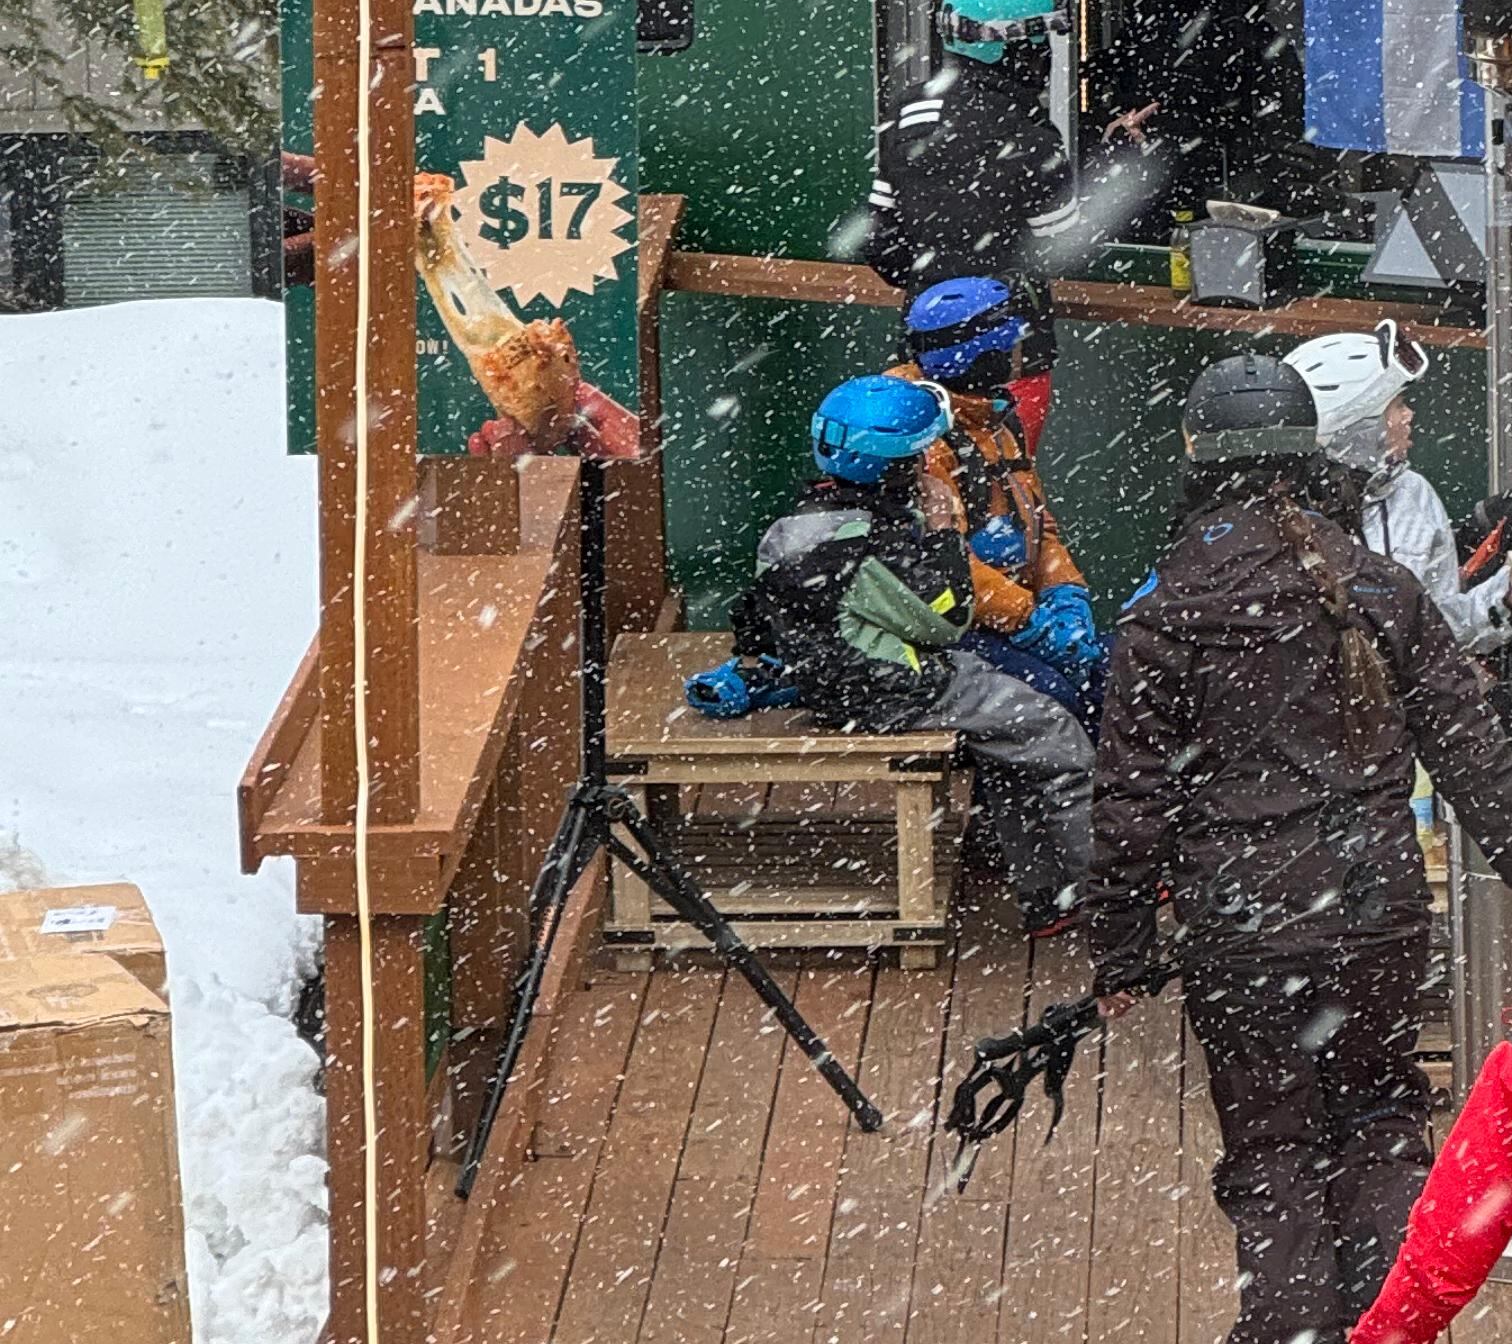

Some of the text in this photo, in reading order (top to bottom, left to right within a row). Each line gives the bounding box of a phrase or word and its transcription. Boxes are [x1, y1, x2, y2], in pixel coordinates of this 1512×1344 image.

[412, 47, 497, 82] T 1
[413, 88, 447, 116] A
[478, 175, 603, 250] $17
[415, 338, 449, 355] OW!
